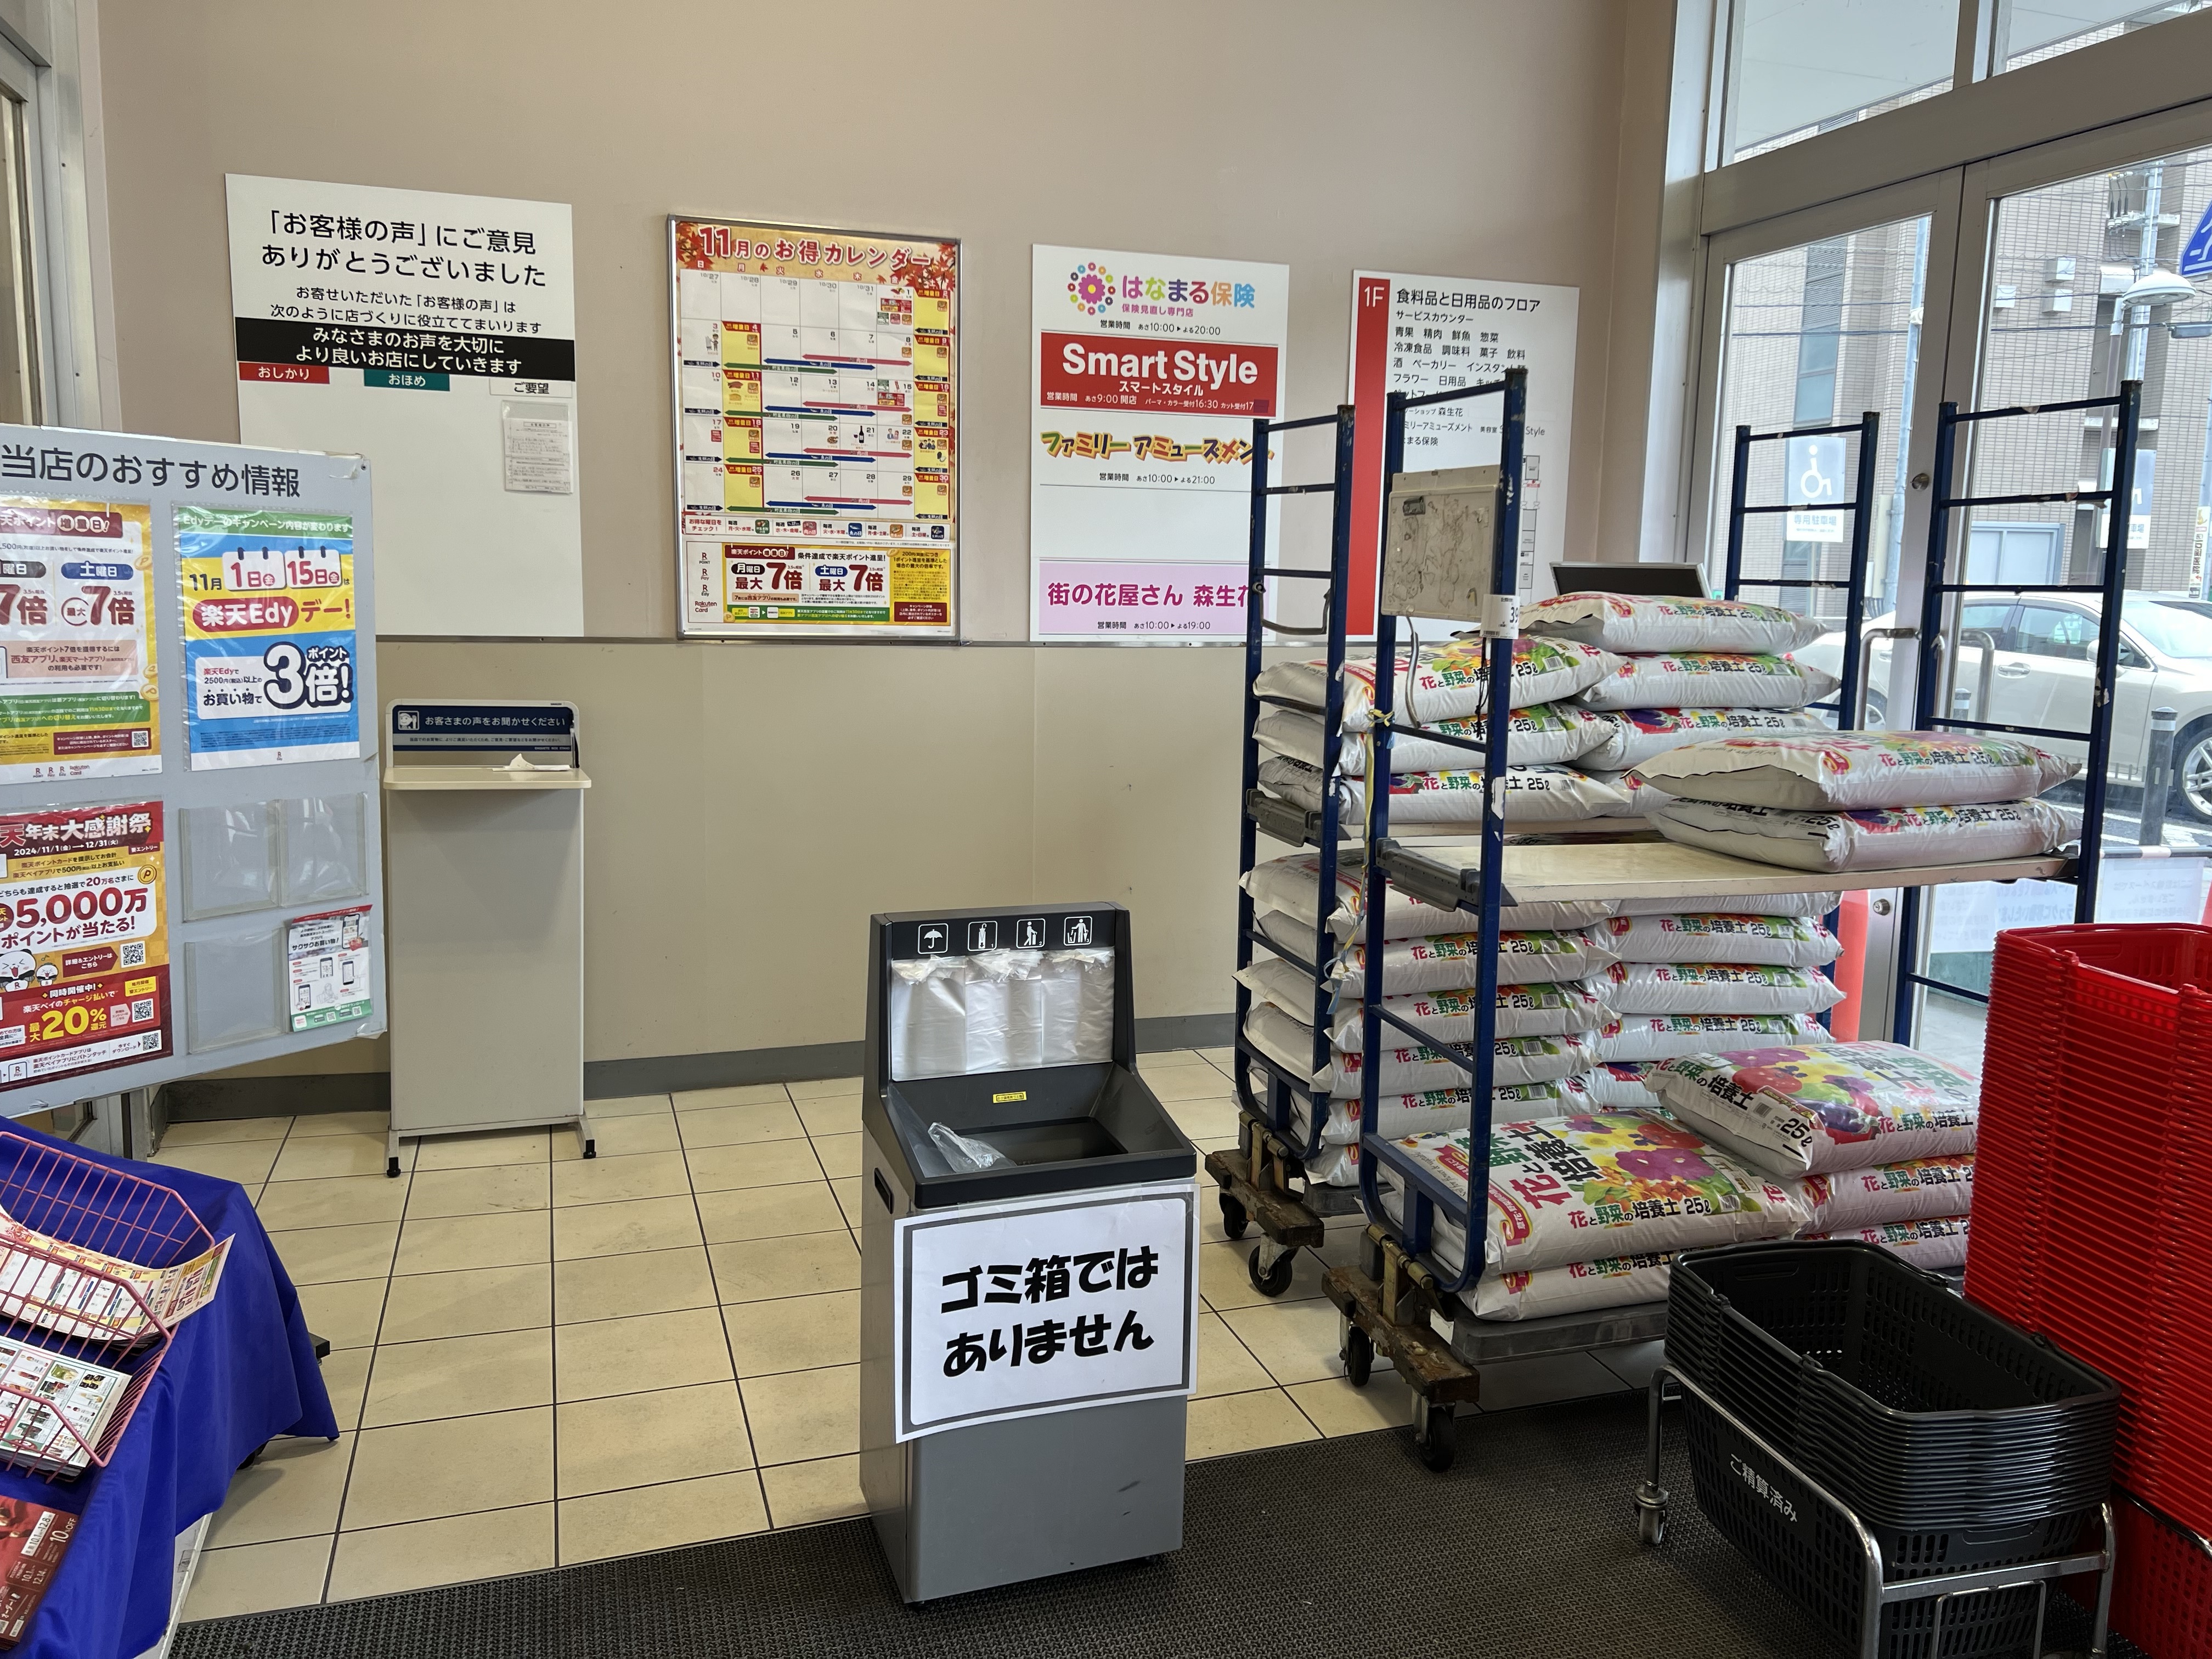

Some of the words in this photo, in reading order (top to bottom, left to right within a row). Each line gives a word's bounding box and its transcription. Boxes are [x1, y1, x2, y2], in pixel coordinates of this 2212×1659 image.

[270, 210, 536, 256] 「お客様の声」にご意見
[698, 226, 932, 271] 11月のお得カレンダー
[262, 244, 546, 287] ありがとうございました
[737, 263, 745, 272] 月
[776, 267, 785, 275] 火
[296, 286, 516, 314] お寄せいただいた「お客様の声」は
[1121, 275, 1256, 309] はなまる保険
[1364, 286, 1385, 307] 1F
[1396, 287, 1541, 313] 食料品と日用品のフロア
[1121, 304, 1194, 317] 保険見直し専門店
[1396, 310, 1474, 323] サービスカウンター
[270, 304, 542, 335] 次のように店づくりに役立ててまいります
[1100, 319, 1131, 330] 営業時間
[313, 327, 505, 354] みなさまのお声を大切に
[1395, 326, 1414, 337] 青果
[1423, 328, 1442, 340] 精肉
[1452, 330, 1470, 341] 鮮魚
[1480, 332, 1499, 343] 惣菜
[1393, 342, 1432, 355] 冷凍食品
[1442, 345, 1470, 357] 調味料
[1480, 347, 1498, 358] 菓子
[1507, 349, 1525, 360] 飲料
[296, 346, 522, 375] より良いお店にしていきます
[1062, 342, 1167, 379] Smart
[1173, 349, 1258, 390] Style
[1393, 357, 1403, 368] 酒
[1412, 359, 1457, 369] ベーカリー
[257, 366, 311, 381] おしかり
[388, 374, 426, 387] おほめ
[1393, 374, 1429, 383] フラワー
[1439, 375, 1466, 387] 日用品
[514, 382, 550, 394] ご要望
[1119, 381, 1204, 396] スマートスタイル
[1047, 392, 1077, 402] 営業時間
[1085, 394, 1118, 404] あさ9:00
[1121, 395, 1137, 405] 開店
[1144, 399, 1218, 409] パーマ・カラー受付16:30
[1438, 407, 1463, 417] 森生花
[1525, 426, 1545, 437] Style
[1040, 431, 1131, 460] ファミリー
[1132, 435, 1274, 465] アミューズメン
[1, 444, 301, 498] 当店のおすすめ情報
[1099, 472, 1129, 482] 営業時間
[1793, 514, 1837, 527] 専用駐車場
[80, 562, 117, 577] 土曜日
[737, 563, 760, 573] 月曜日
[766, 562, 802, 590] 7倍
[820, 565, 843, 575] 土曜日
[189, 573, 222, 591] 11月
[736, 577, 763, 590] 最大
[819, 579, 845, 591] 最大
[849, 565, 884, 591] 7倍
[1047, 582, 1183, 607] 街の花屋さん
[66, 607, 86, 616] 最大
[82, 585, 135, 625] 7倍
[1657, 605, 1737, 618] 花と野菜の培養土
[1097, 621, 1126, 629] 営業時間
[307, 647, 347, 659] ポイント
[1661, 660, 1745, 673] 花と野菜の培養土
[203, 691, 263, 707] お買い物で
[425, 716, 565, 726] お客さまの声をお聞かせください
[1680, 715, 1763, 729] 花と野菜の培養土
[1878, 751, 1971, 767] 花と野菜の培養土
[1904, 809, 1997, 827] 花と野菜の培養土
[14, 844, 71, 856] 2024/11/1(金)
[85, 839, 119, 849] 12/31(火)
[21, 852, 117, 868] 楽天ポイントカードを提示してお会計
[16, 887, 148, 928] 5,000万
[1, 916, 136, 949] ポイントが当たる!
[1659, 919, 1748, 934] 花と野菜の培養土
[1655, 967, 1744, 983] 花と野菜の培養土
[49, 983, 96, 998] 同時開催中!
[23, 991, 116, 1014] 楽天ペイのチャージ払いで
[91, 1022, 107, 1031] 還元
[1650, 1018, 1738, 1033] 花と野菜の培養土
[112, 1046, 137, 1054] ダウンロード
[1877, 1109, 1974, 1133] 花と野菜の培養土
[1507, 1125, 1606, 1182] 培養土
[1864, 1164, 1962, 1193] 花と野菜の培養土
[1567, 1198, 1681, 1229] 花と野菜の培養土
[1861, 1220, 1961, 1245] 花と野菜の培養土
[941, 1245, 1159, 1314] ゴミ箱では
[943, 1310, 1155, 1378] ありません
[1730, 1453, 1798, 1523] ご精算済み
